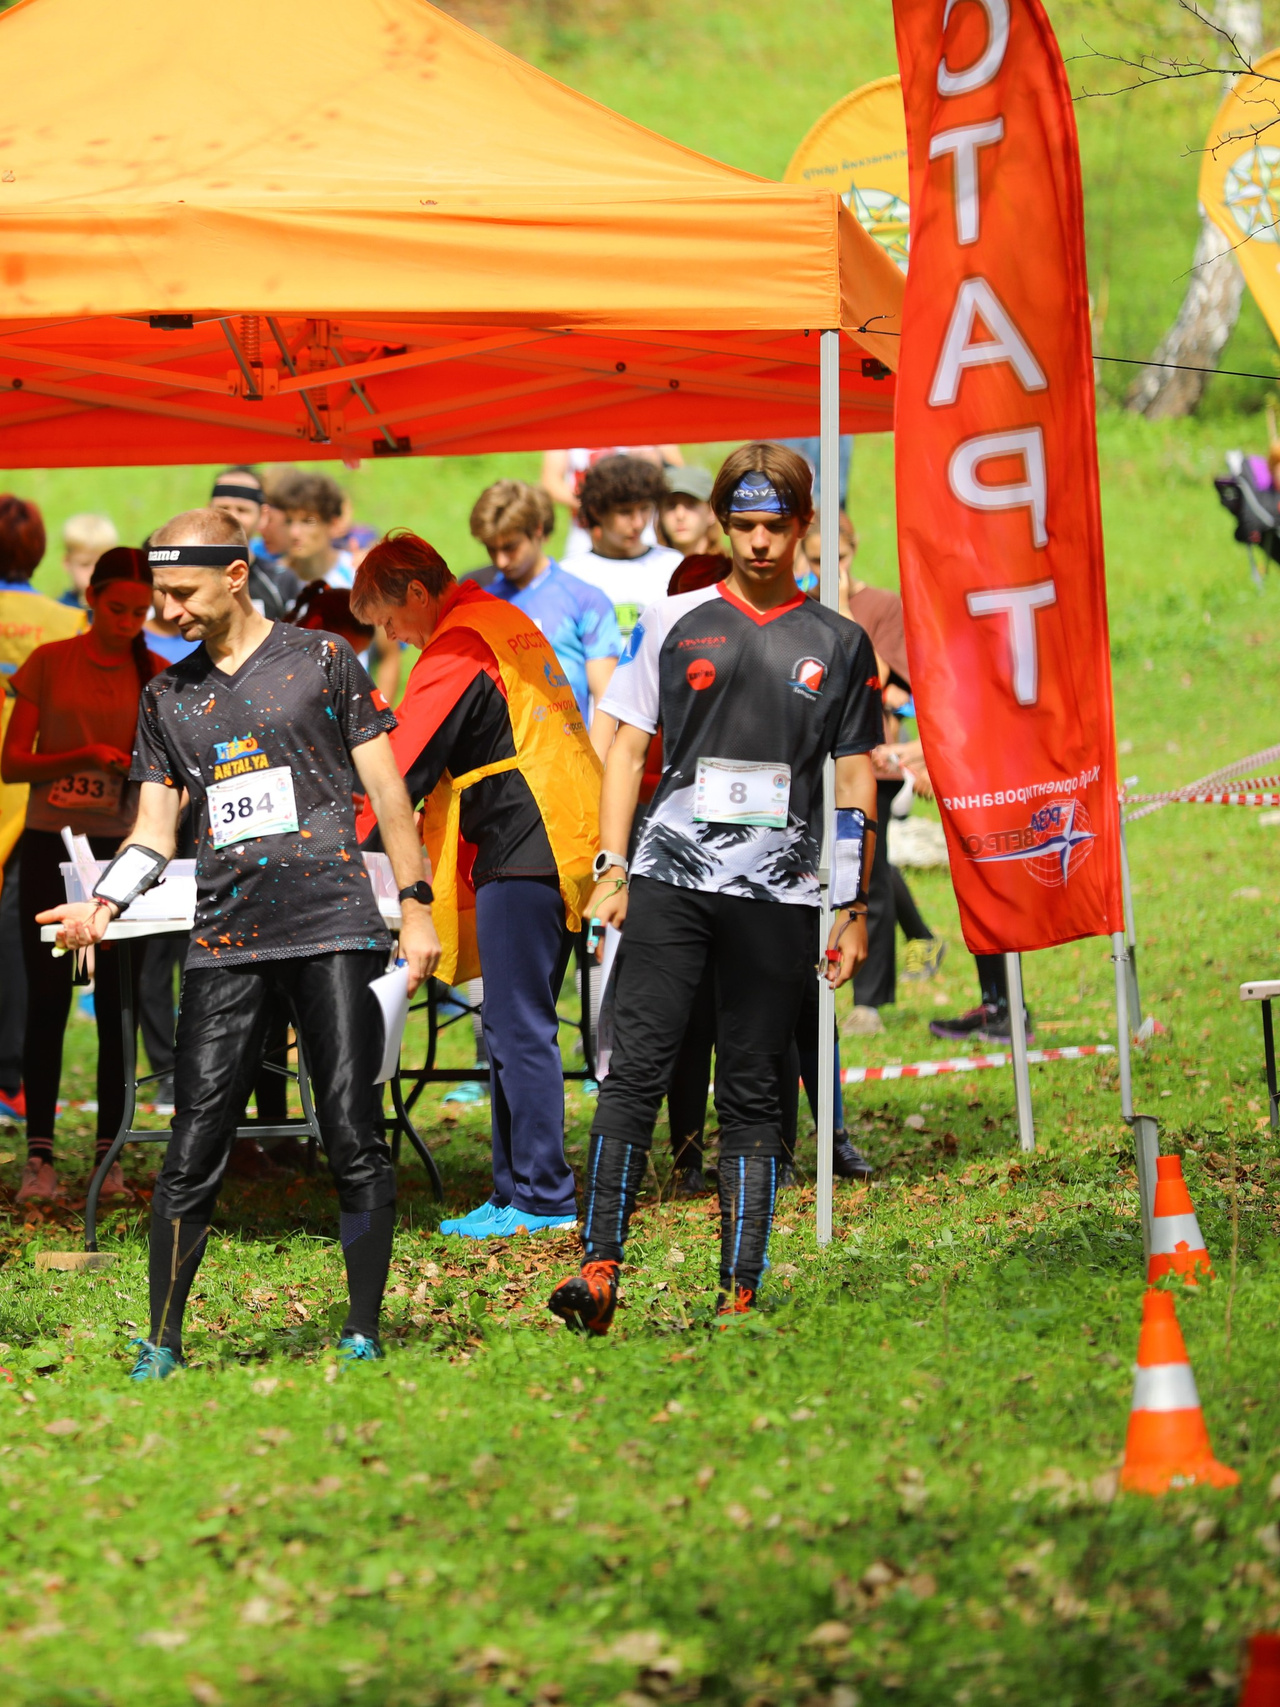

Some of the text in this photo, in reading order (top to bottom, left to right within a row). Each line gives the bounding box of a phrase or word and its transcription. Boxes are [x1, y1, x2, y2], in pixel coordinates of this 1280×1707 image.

[214, 753, 270, 780] ANTALYA
[61, 774, 104, 798] 333
[729, 782, 748, 804] 8
[221, 792, 274, 824] 384
